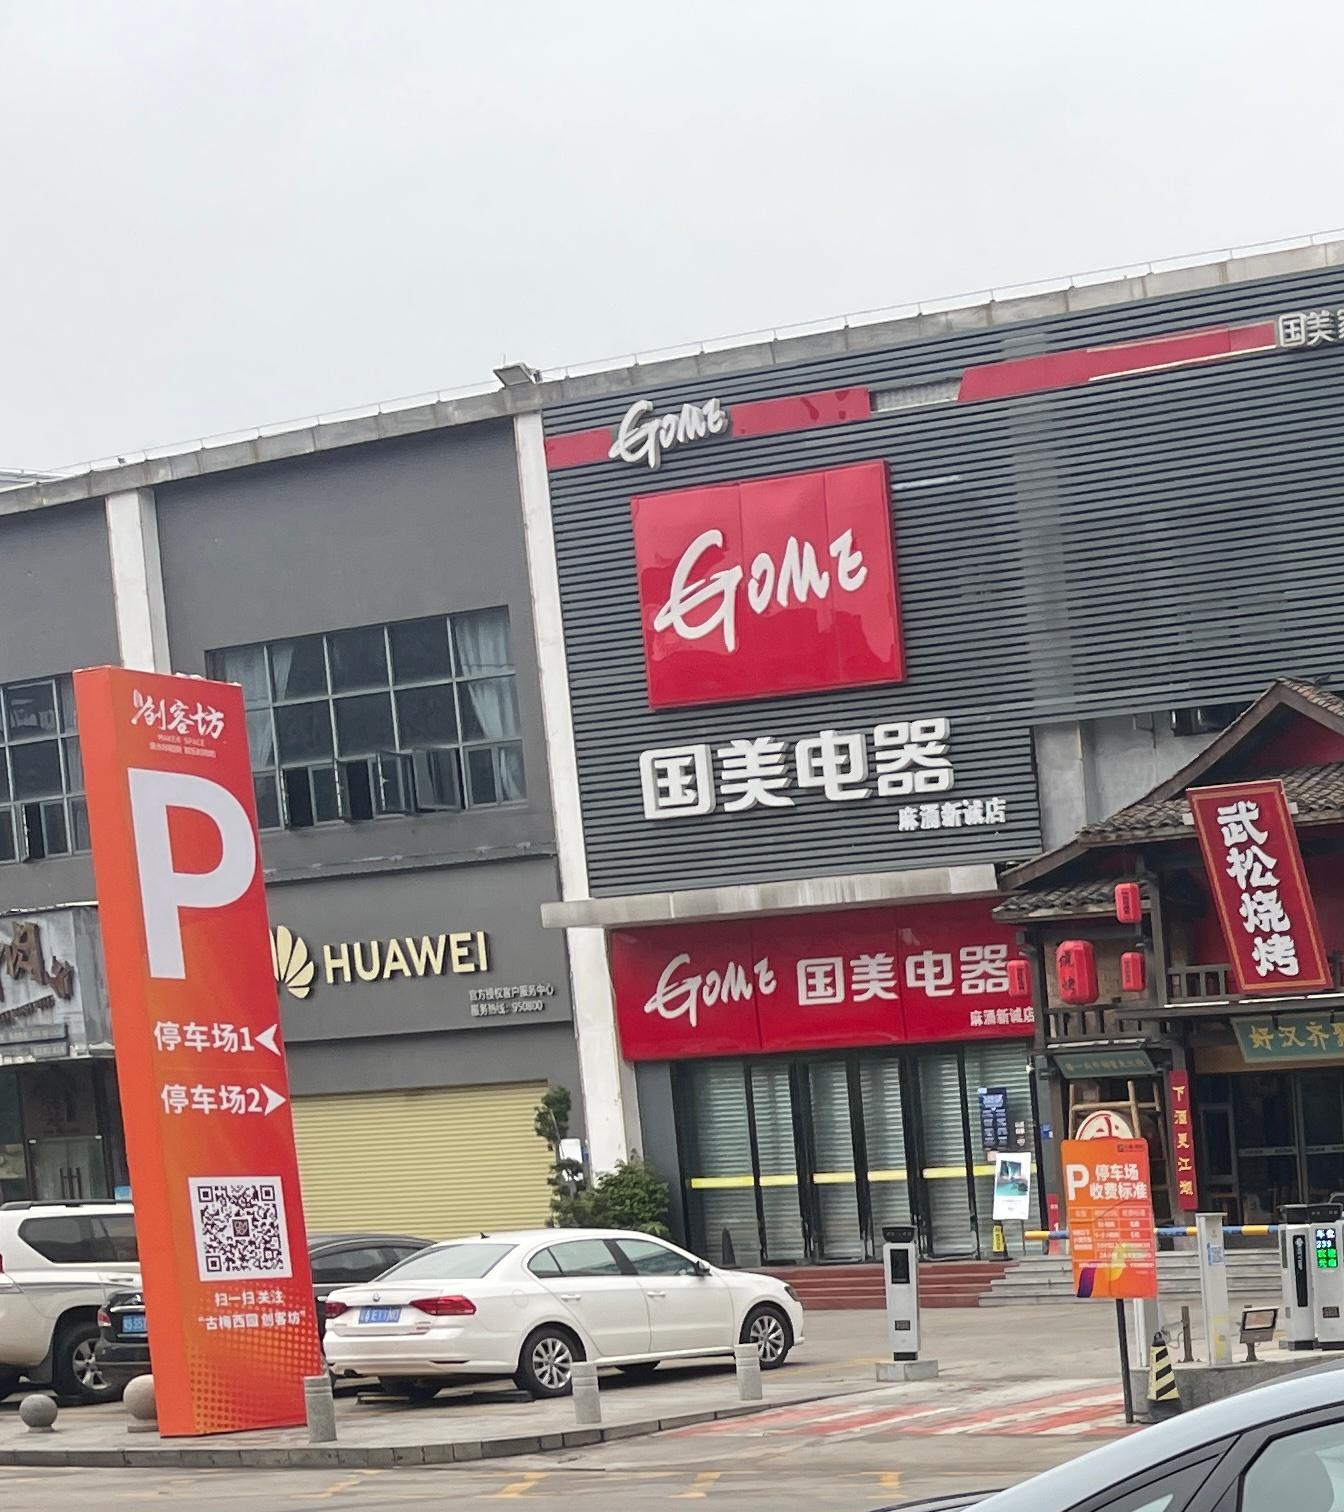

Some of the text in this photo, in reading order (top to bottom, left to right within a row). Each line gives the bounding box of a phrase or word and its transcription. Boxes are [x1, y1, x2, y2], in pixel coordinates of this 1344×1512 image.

[638, 717, 956, 819] 国美电器
[128, 768, 257, 980] P
[1217, 800, 1299, 977] 武松烧烤
[323, 931, 488, 984] HUAWEI
[797, 944, 1009, 1006] 国美电器
[154, 1021, 255, 1053] 停车场1
[161, 1083, 262, 1115] 停车场2
[1066, 1163, 1090, 1200] P
[1090, 1182, 1148, 1200] 收费标准
[1095, 1163, 1139, 1181] 停车场
